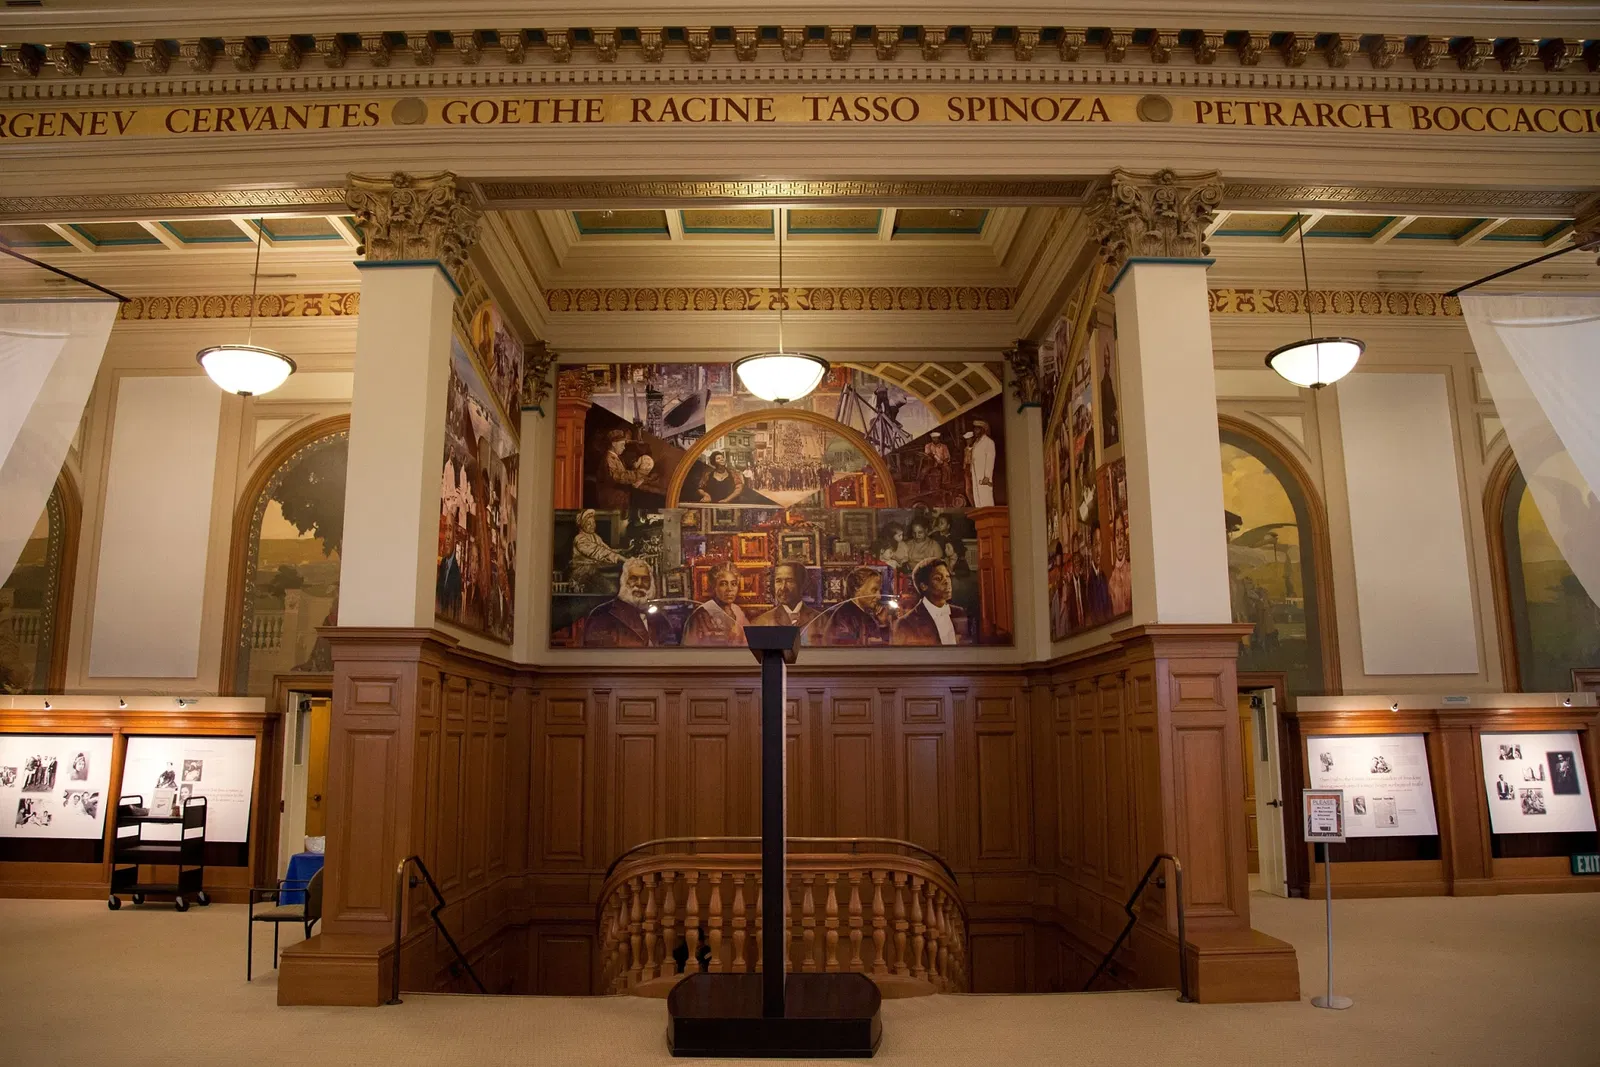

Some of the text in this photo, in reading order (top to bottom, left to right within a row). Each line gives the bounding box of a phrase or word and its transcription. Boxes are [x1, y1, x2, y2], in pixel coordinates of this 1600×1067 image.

[165, 102, 380, 134] CERVANTES
[441, 98, 605, 125] GOETHE
[629, 97, 777, 123] RACINE
[802, 95, 920, 122] TASSO
[947, 96, 1111, 122] SPINOZA
[1193, 100, 1393, 129] PETRARCH
[1409, 105, 1600, 134] BOCCACCI
[1577, 855, 1600, 873] EXIT
